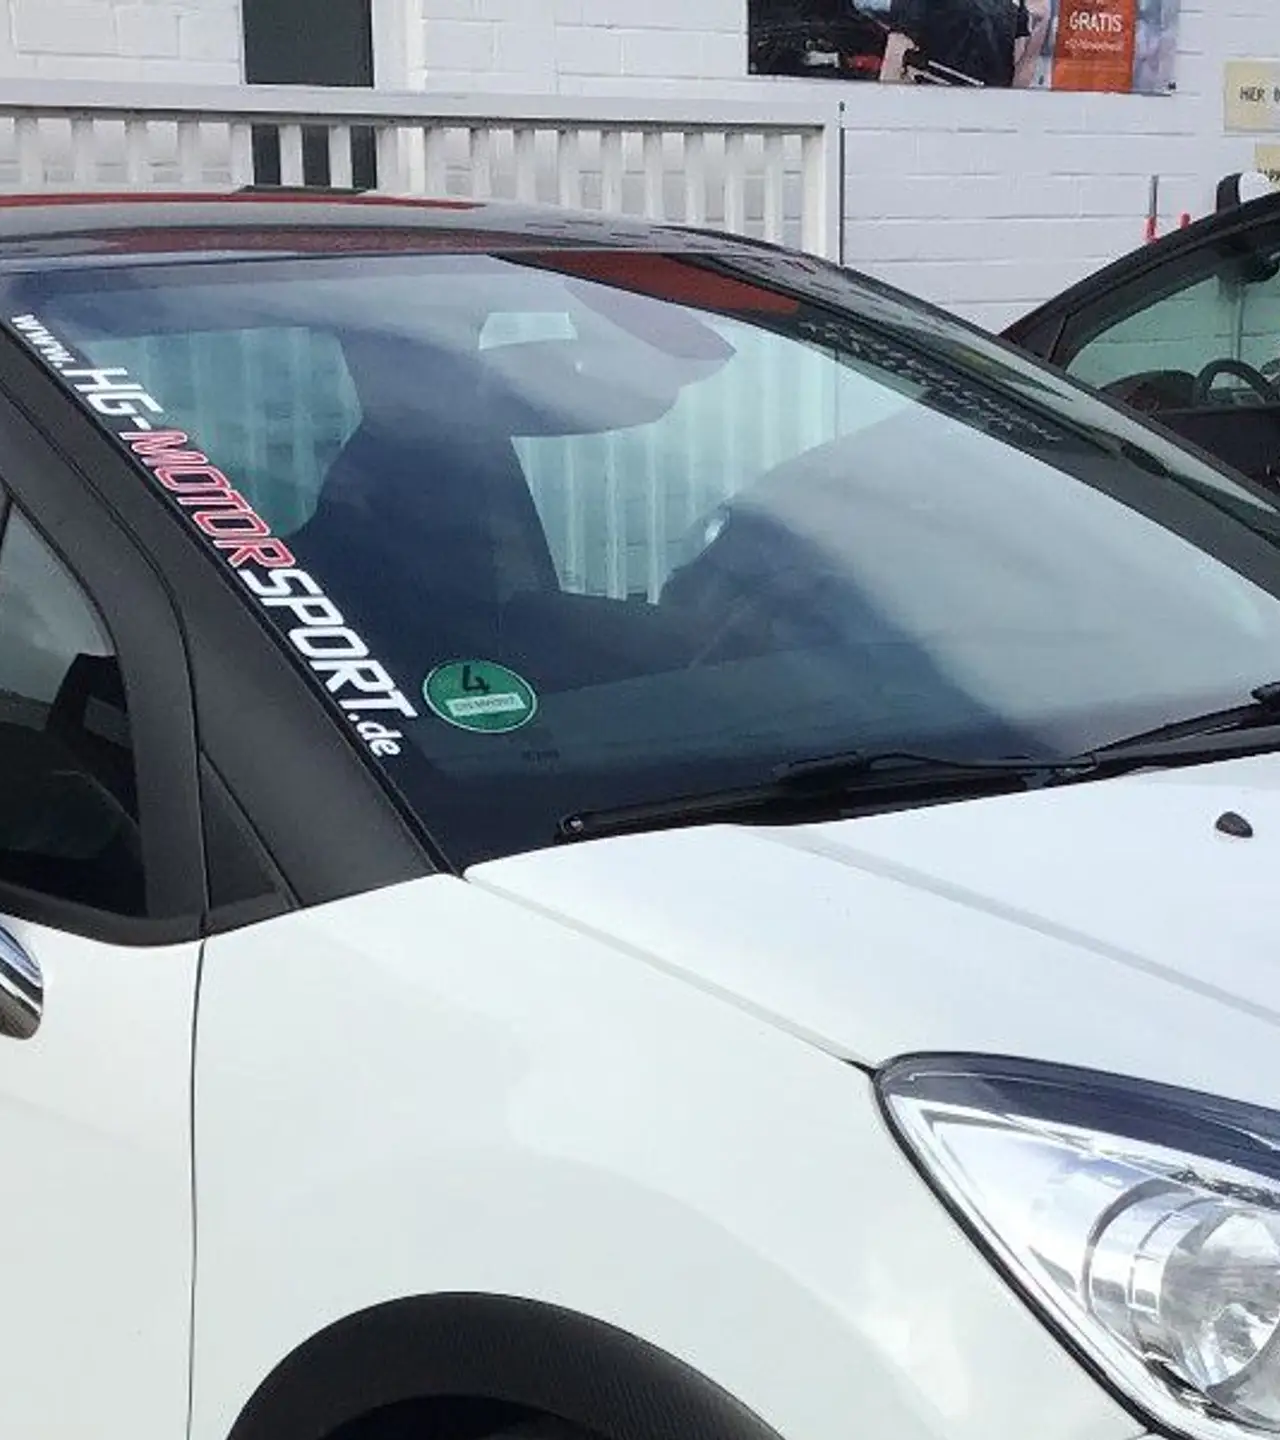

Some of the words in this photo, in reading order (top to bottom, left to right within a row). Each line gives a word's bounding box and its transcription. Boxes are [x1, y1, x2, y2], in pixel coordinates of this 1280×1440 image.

[1069, 11, 1122, 33] GRATIS
[1239, 86, 1265, 102] HIER
[462, 665, 491, 692] 4
